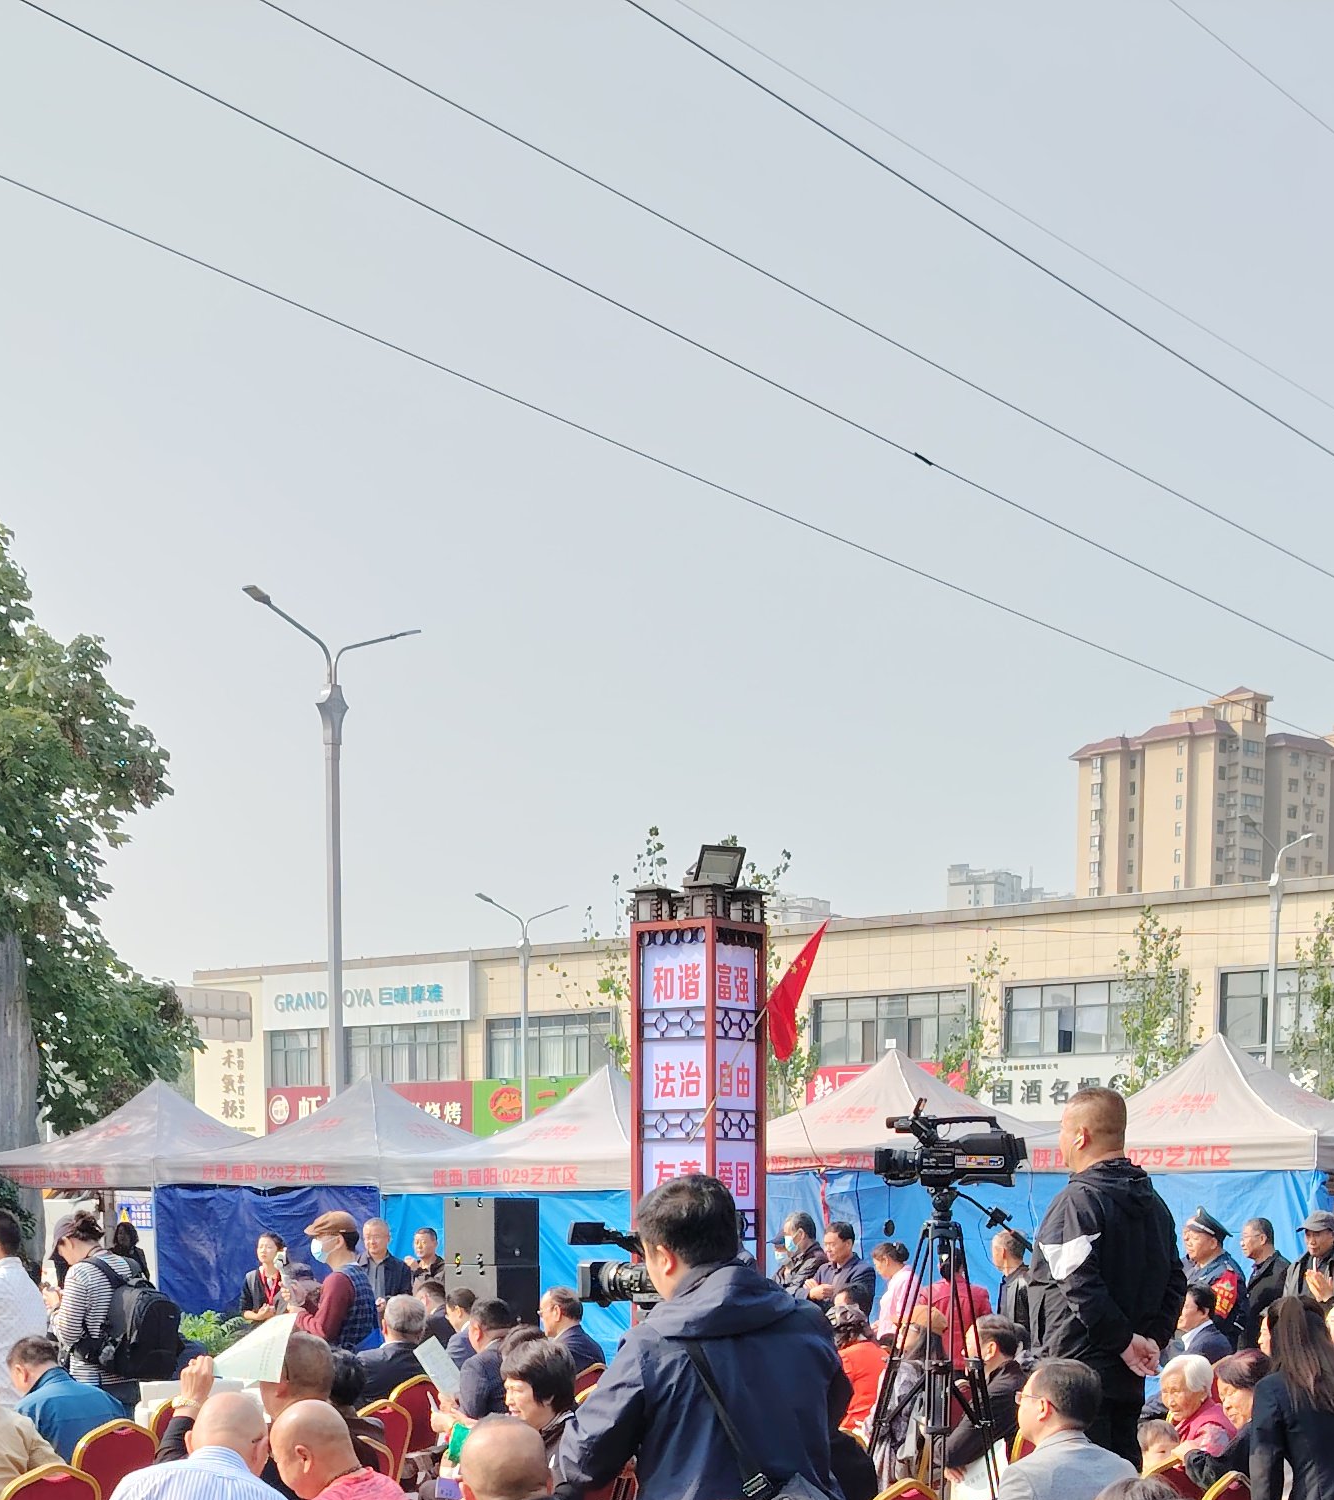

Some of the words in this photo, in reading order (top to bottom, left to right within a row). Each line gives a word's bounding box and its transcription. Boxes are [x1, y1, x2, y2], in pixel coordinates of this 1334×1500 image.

[274, 991, 328, 1012] GRAND
[341, 988, 375, 1008] OYA
[652, 962, 701, 1003] 和谐
[717, 963, 750, 1003] 富强
[653, 1060, 702, 1099] 法治
[719, 1061, 750, 1098] 自由
[412, 1102, 462, 1125] 烧烤
[718, 1161, 750, 1196] 爱国
